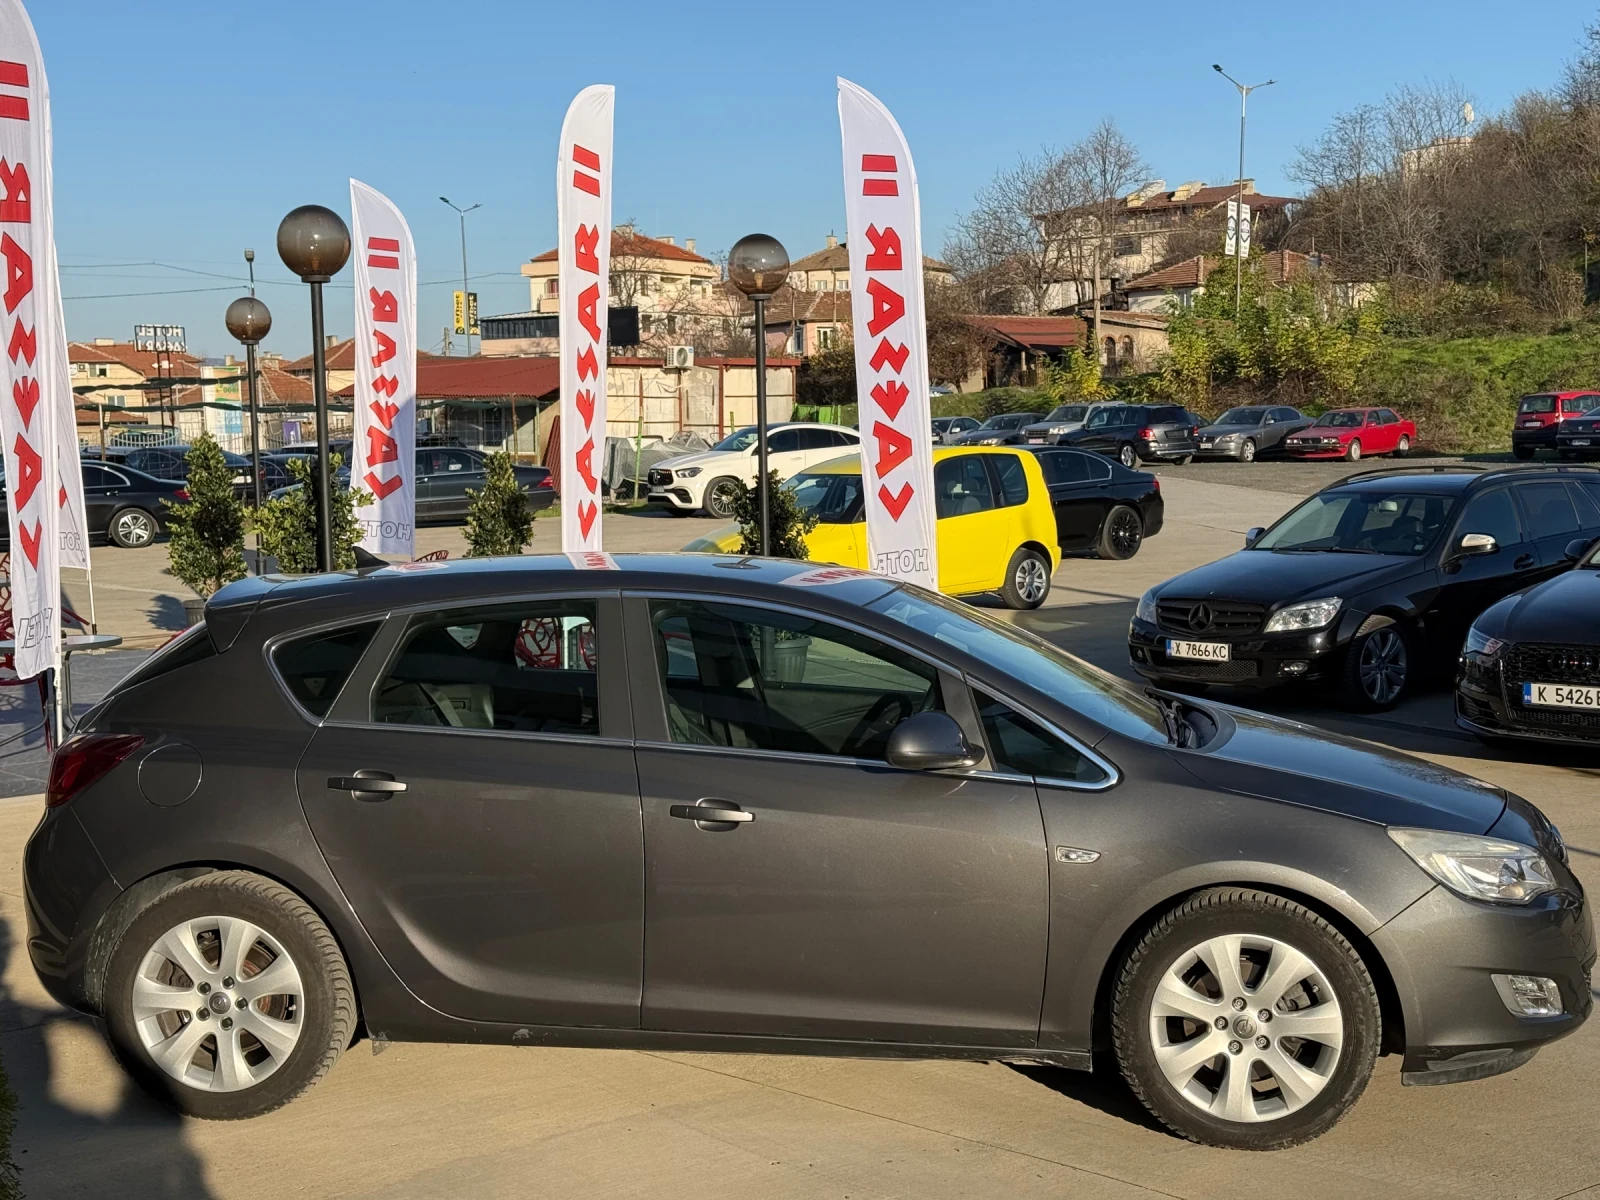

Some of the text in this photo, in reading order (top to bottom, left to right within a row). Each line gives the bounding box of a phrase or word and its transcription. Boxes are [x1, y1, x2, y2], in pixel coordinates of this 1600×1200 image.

[575, 223, 602, 541] CAESAR
[1185, 643, 1211, 657] 7866
[1212, 645, 1227, 658] KC
[1538, 686, 1547, 702] K
[1555, 687, 1594, 705] 5426
